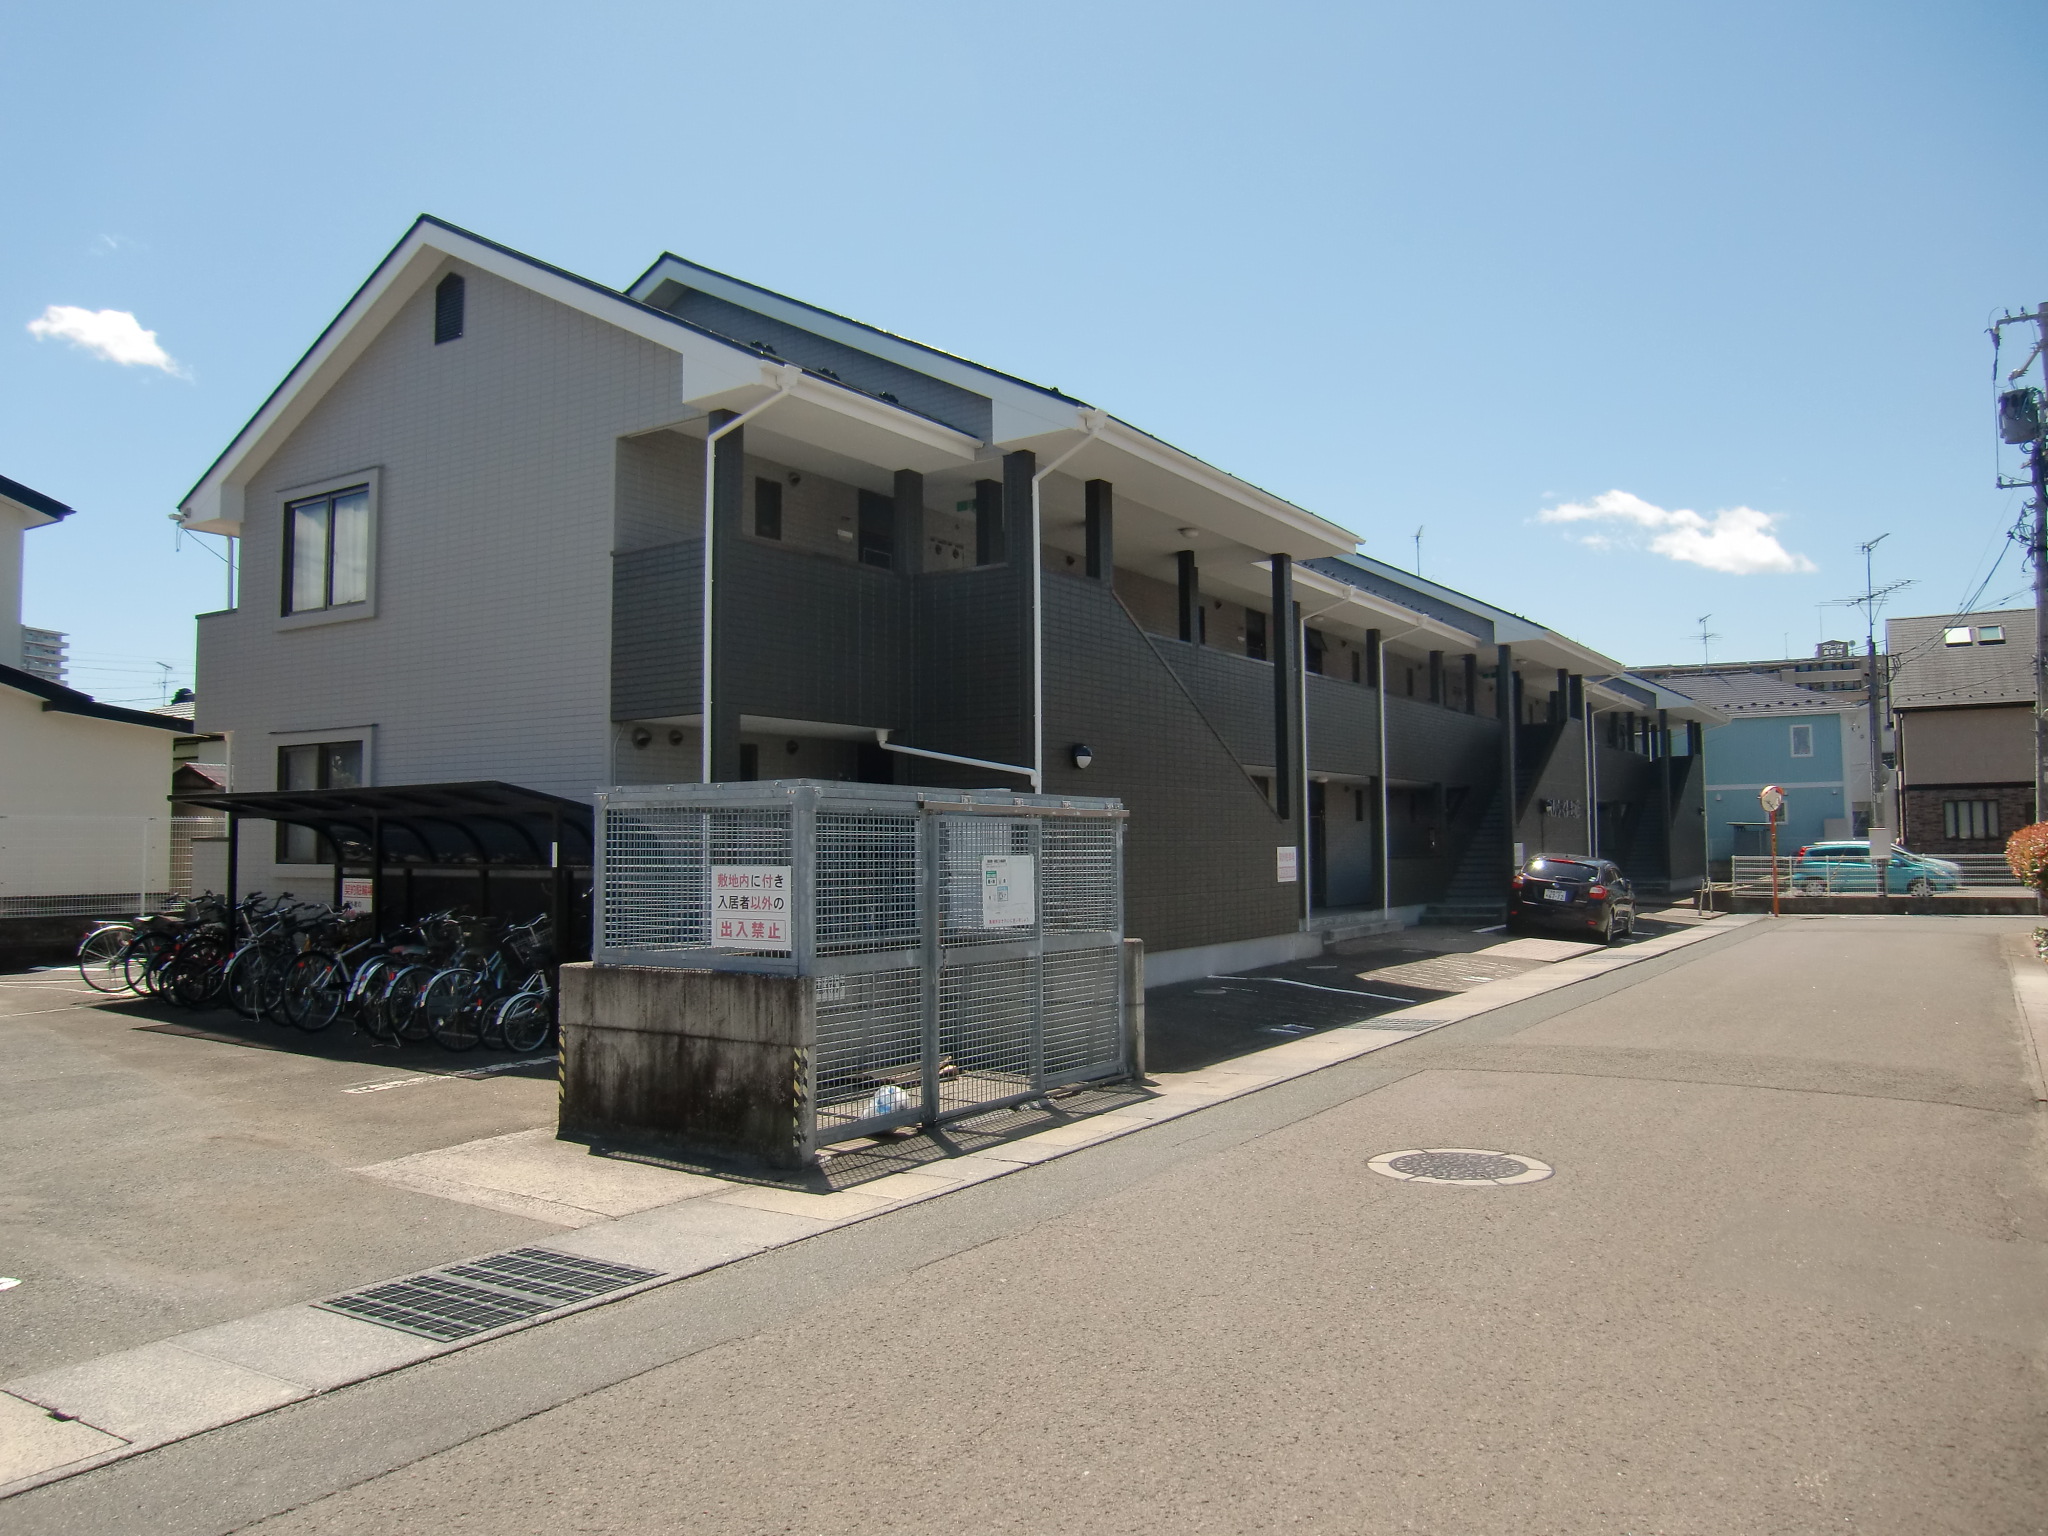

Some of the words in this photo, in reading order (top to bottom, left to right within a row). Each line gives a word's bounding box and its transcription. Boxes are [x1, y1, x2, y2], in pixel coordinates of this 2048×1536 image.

[717, 873, 784, 889] 敷地内に付き
[717, 895, 785, 910] 入居者以外の
[720, 920, 781, 939] 出入禁止
